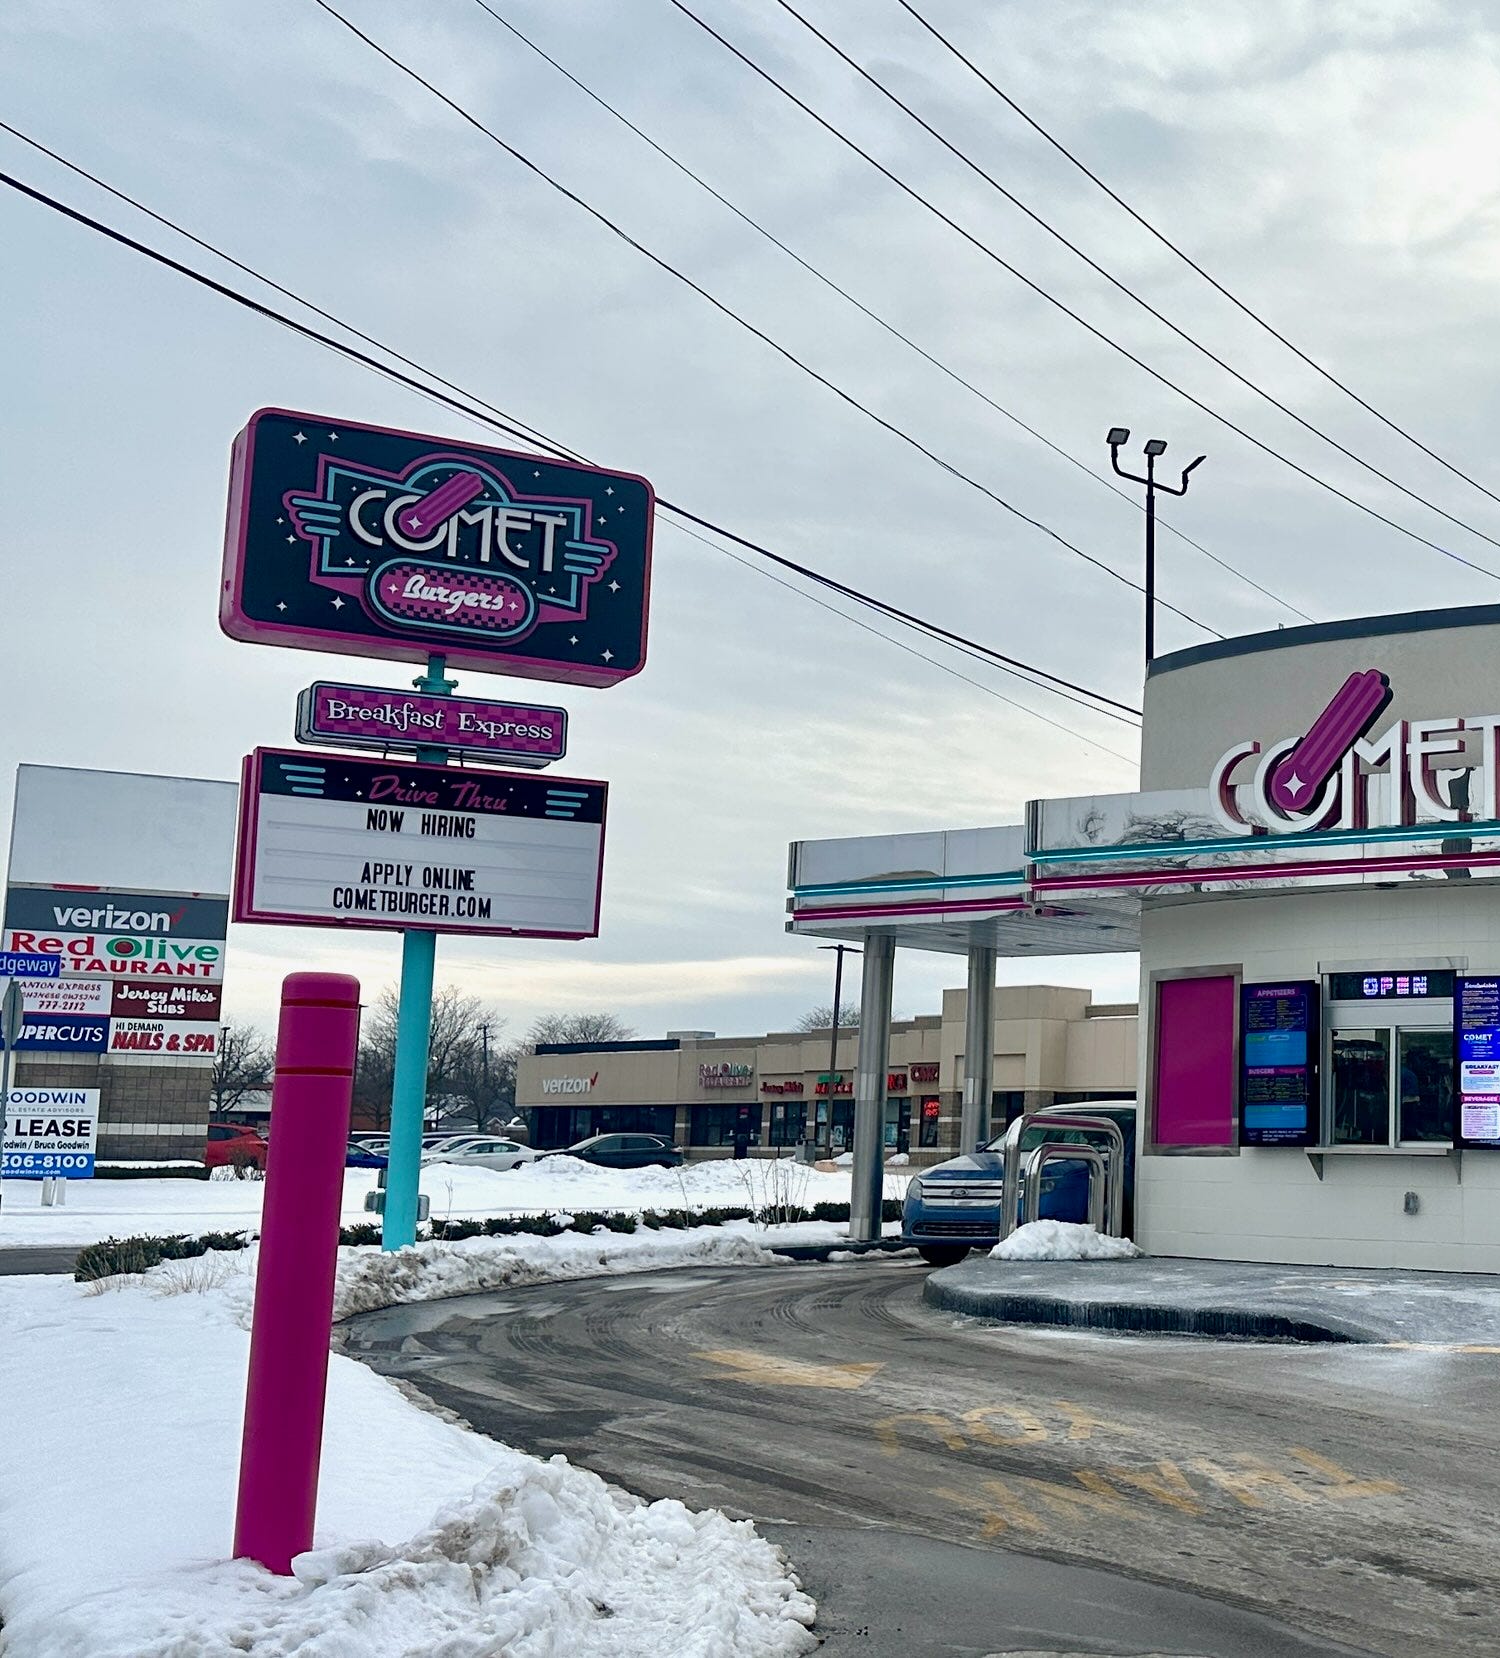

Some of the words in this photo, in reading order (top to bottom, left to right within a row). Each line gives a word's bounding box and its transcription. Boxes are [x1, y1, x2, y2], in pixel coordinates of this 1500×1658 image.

[349, 490, 567, 572] COMET
[402, 574, 504, 615] Burgers
[327, 699, 445, 732] Breakfast
[458, 712, 553, 740] Express
[369, 774, 439, 805] Drive
[450, 780, 508, 812] Thru
[366, 808, 404, 832] NOW
[421, 812, 476, 838] HIRING
[361, 862, 414, 888] APPLY
[422, 867, 476, 891] ONLINE
[333, 887, 492, 919] COMETBURGER.COM
[53, 903, 170, 932] verizon
[11, 931, 95, 954] Red
[106, 937, 220, 962] Olive
[20, 981, 56, 989] ANTON
[58, 983, 102, 991] EXPRESS
[117, 984, 168, 1004] Jersey
[170, 986, 217, 1003] Mike's
[1363, 976, 1428, 995] OPEN
[38, 1000, 86, 1011] 777-2112
[17, 1025, 104, 1042] UPERCUTS
[127, 1022, 164, 1032] DEMAND
[111, 1031, 164, 1051] NAILS
[166, 1034, 181, 1052] &
[182, 1034, 215, 1053] SPA
[542, 1074, 591, 1094] verizon
[14, 1119, 92, 1137] LEASE
[34, 1141, 56, 1150] Bruce
[57, 1140, 90, 1150] Goodwin
